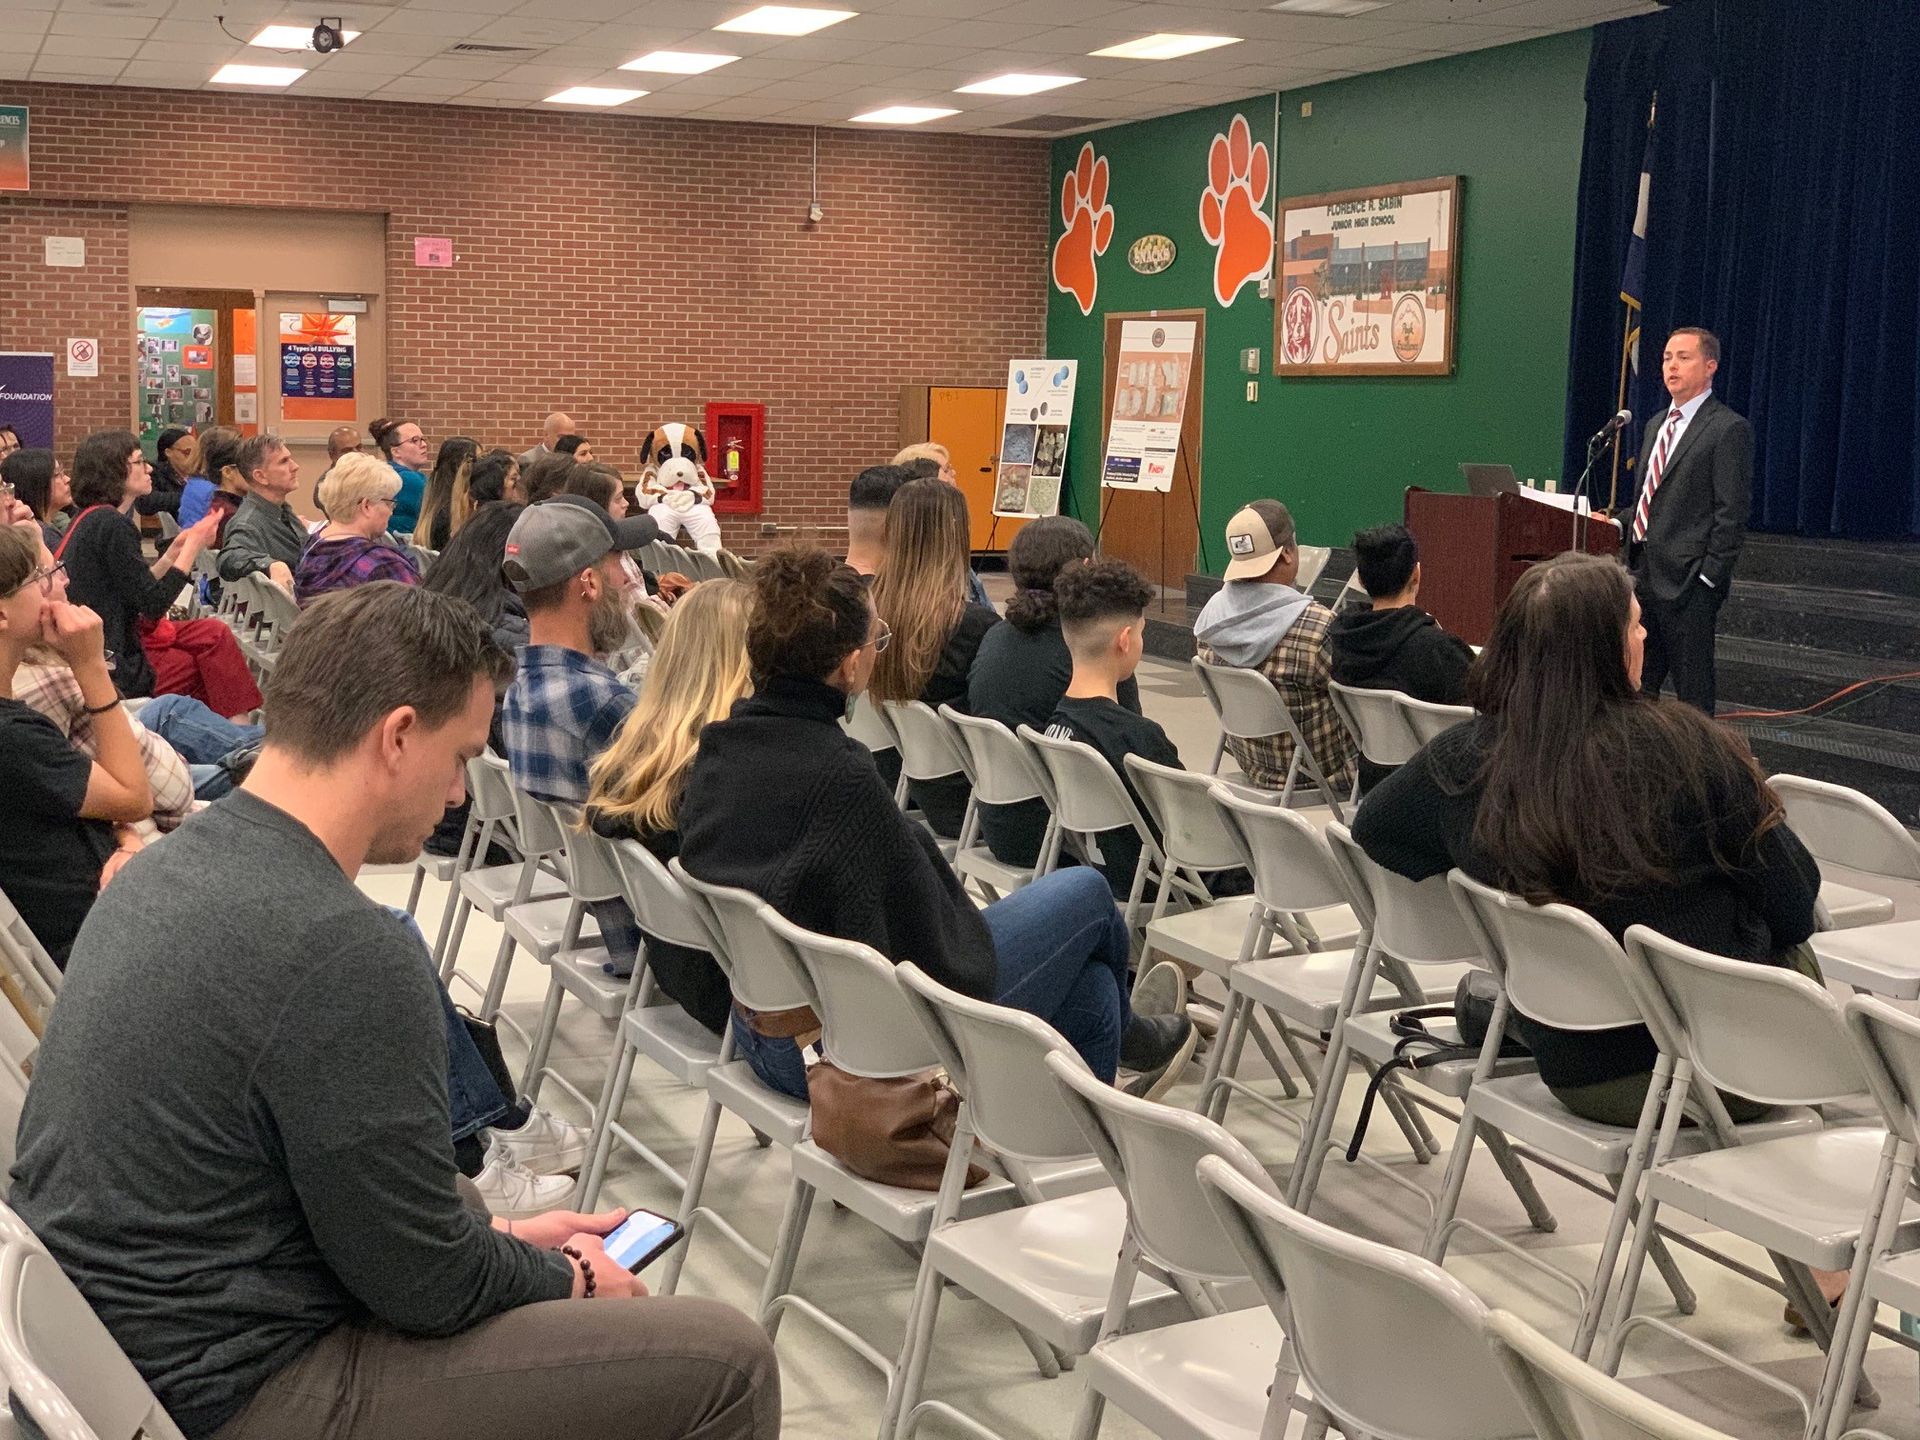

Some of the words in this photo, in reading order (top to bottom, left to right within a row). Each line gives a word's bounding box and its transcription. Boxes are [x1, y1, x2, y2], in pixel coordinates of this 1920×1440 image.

[0, 115, 20, 125] ENCES
[1327, 201, 1366, 216] FLORENCE
[1379, 196, 1403, 211] SABIN
[1331, 219, 1352, 231] JUNIOR
[1354, 217, 1369, 228] HIGH
[1370, 214, 1396, 227] SCHOOL
[1323, 300, 1380, 363] Saints
[0, 392, 53, 401] FOUNDATION
